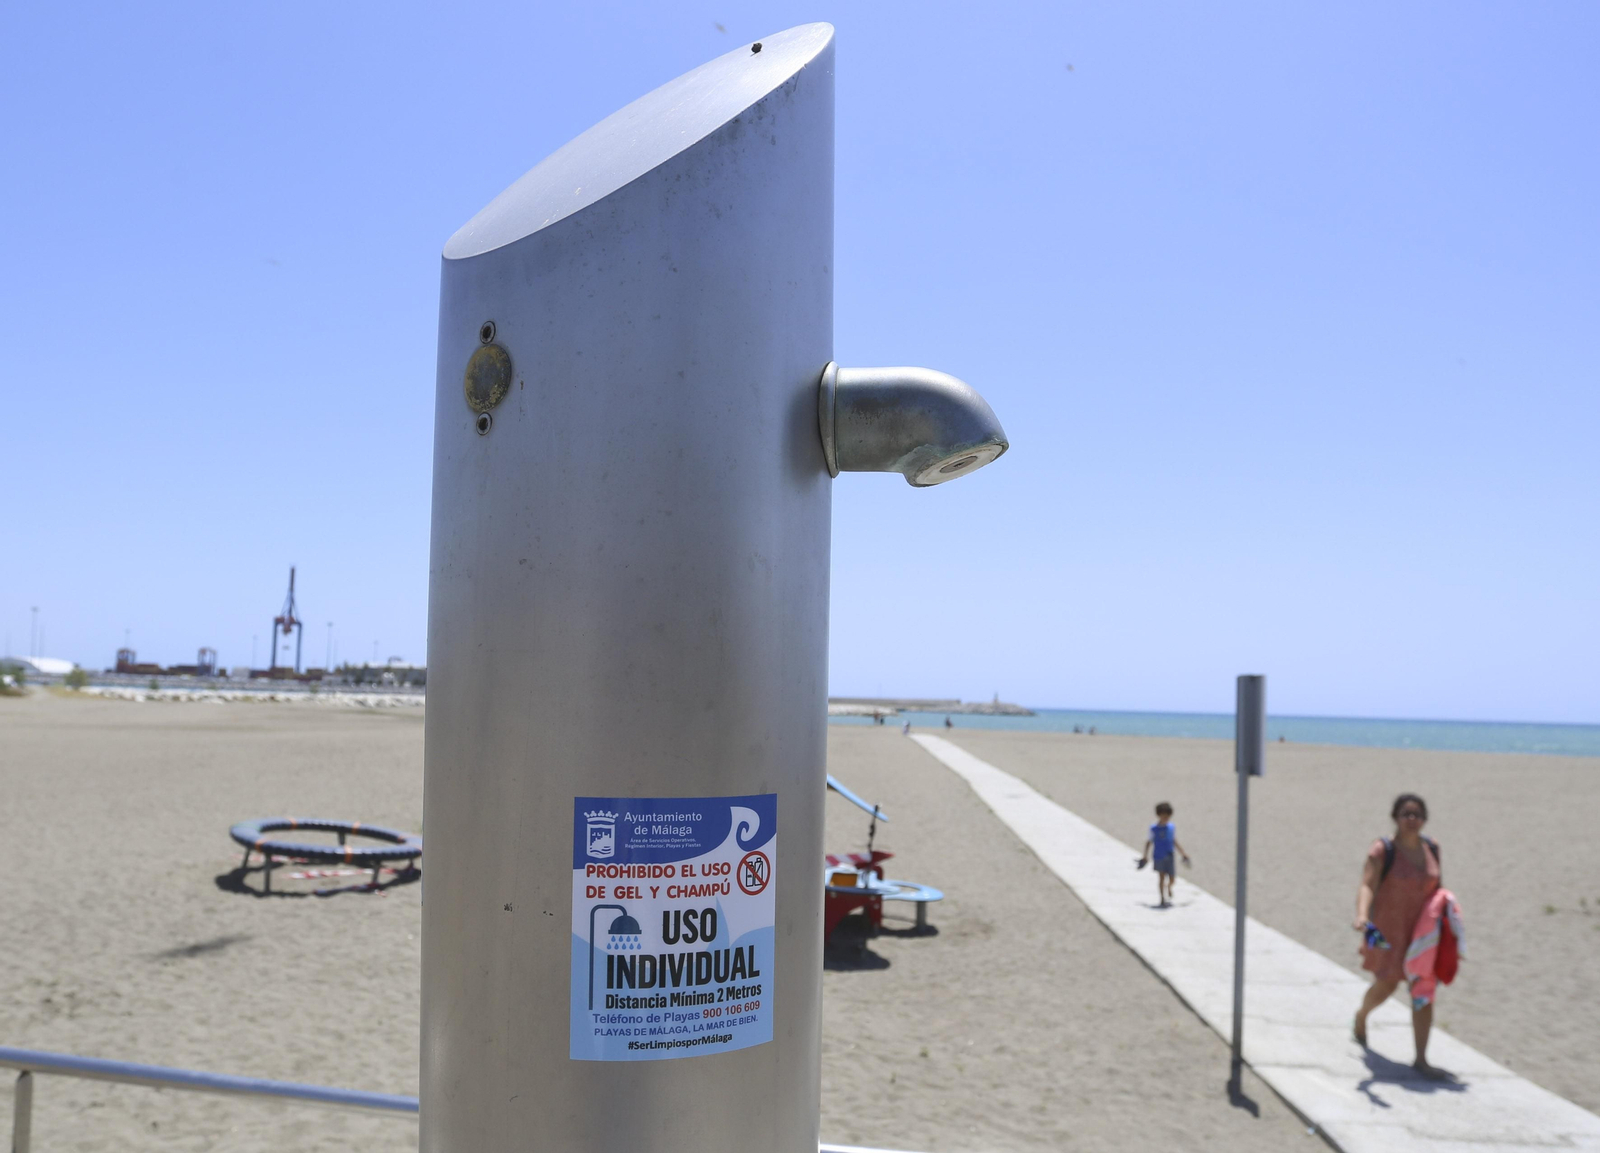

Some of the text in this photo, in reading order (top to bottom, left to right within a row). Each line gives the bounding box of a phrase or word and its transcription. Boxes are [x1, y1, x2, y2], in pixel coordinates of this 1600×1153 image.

[624, 812, 702, 824] Ayuntamiento
[634, 824, 692, 836] de Málaga
[586, 862, 731, 878] PROHIBIDO EL USO
[586, 878, 730, 899] DE GEL Y CHAMPÚ
[662, 908, 717, 944] USO
[606, 944, 760, 989] INDIVIDUAL
[606, 984, 762, 1009] Distancia Mínima 2 Metros
[592, 1000, 760, 1024] Teléfono de Playas 900 106 609
[594, 1014, 758, 1036] PLAYAS DE MÁLAGA, LA MAR DE BIEN.
[628, 1034, 732, 1050] #SerLimpiosporMálaga
